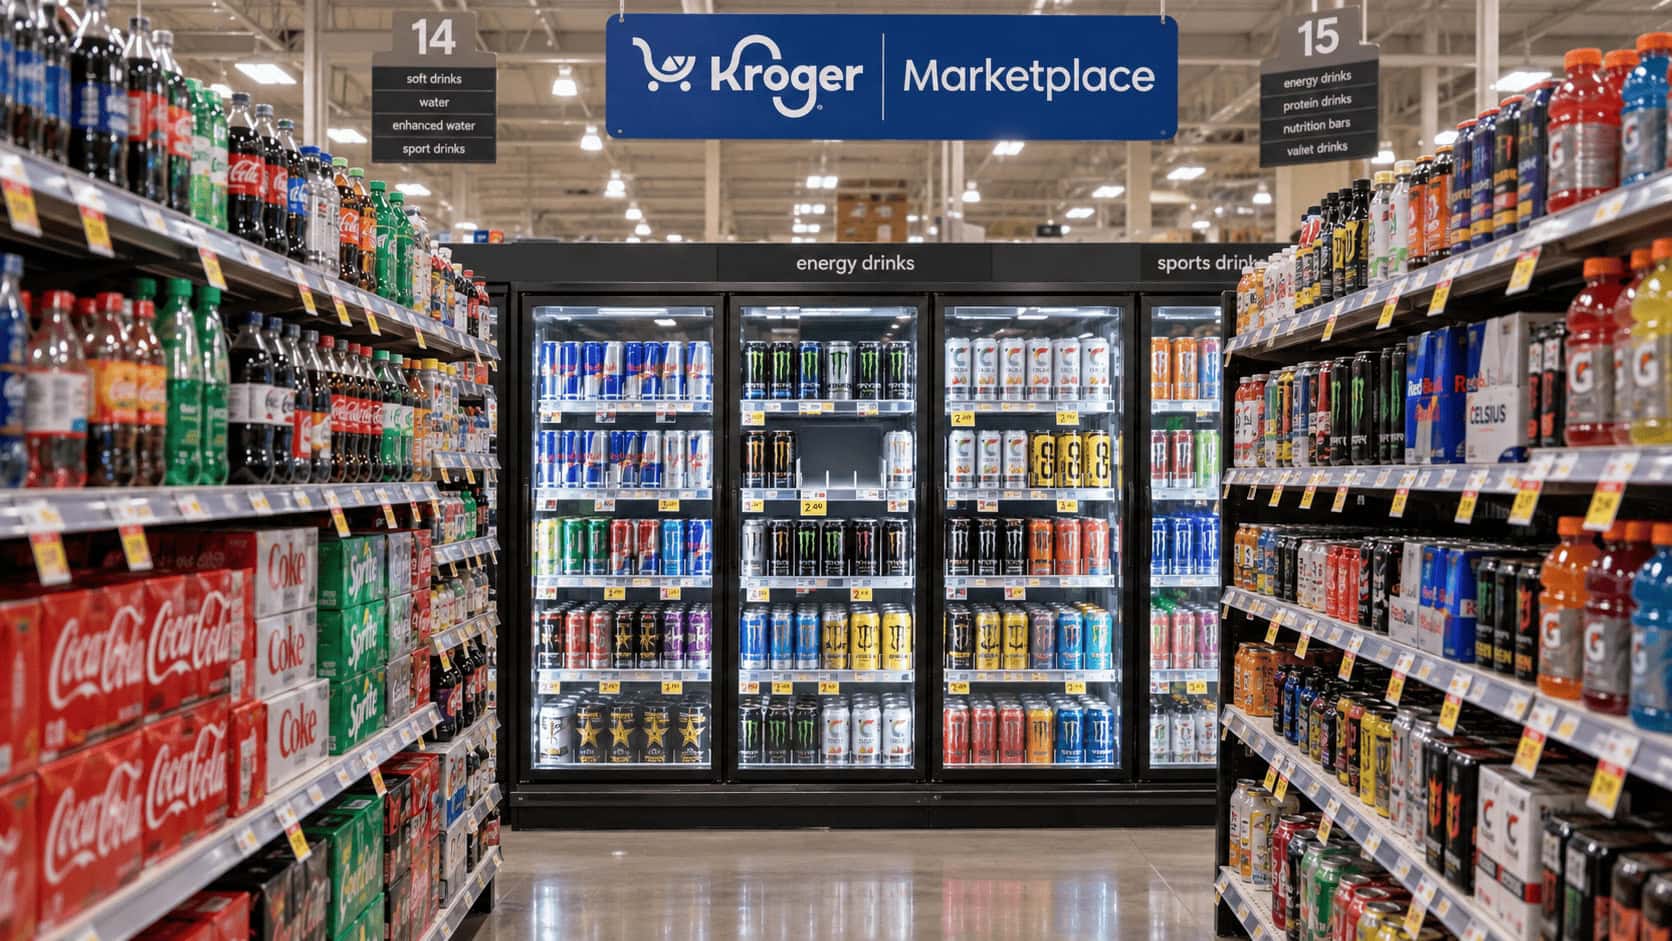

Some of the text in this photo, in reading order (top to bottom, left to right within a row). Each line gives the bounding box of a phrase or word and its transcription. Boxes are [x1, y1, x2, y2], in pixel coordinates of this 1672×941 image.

[411, 18, 456, 55] 14
[1298, 16, 1339, 56] 15
[407, 72, 462, 84] soft drinks
[711, 34, 1155, 118] Kroger Marketplace
[1283, 70, 1352, 88] energy drinks
[419, 97, 450, 107] water
[1283, 94, 1352, 114] protein drinks
[392, 120, 476, 131] enhanced water
[1283, 118, 1351, 134] nutrition bars
[402, 143, 465, 156] sport drinks
[1317, 140, 1348, 154] drinks
[797, 255, 915, 274] energy drinks
[1157, 254, 1257, 274] sports drink
[1470, 404, 1506, 425] CELSIUS
[268, 542, 306, 592] Coke
[348, 546, 377, 602] Sprite
[268, 625, 305, 675] Coke
[348, 613, 378, 671] Sprite
[348, 683, 378, 743] Sprite
[279, 702, 318, 759] Coke
